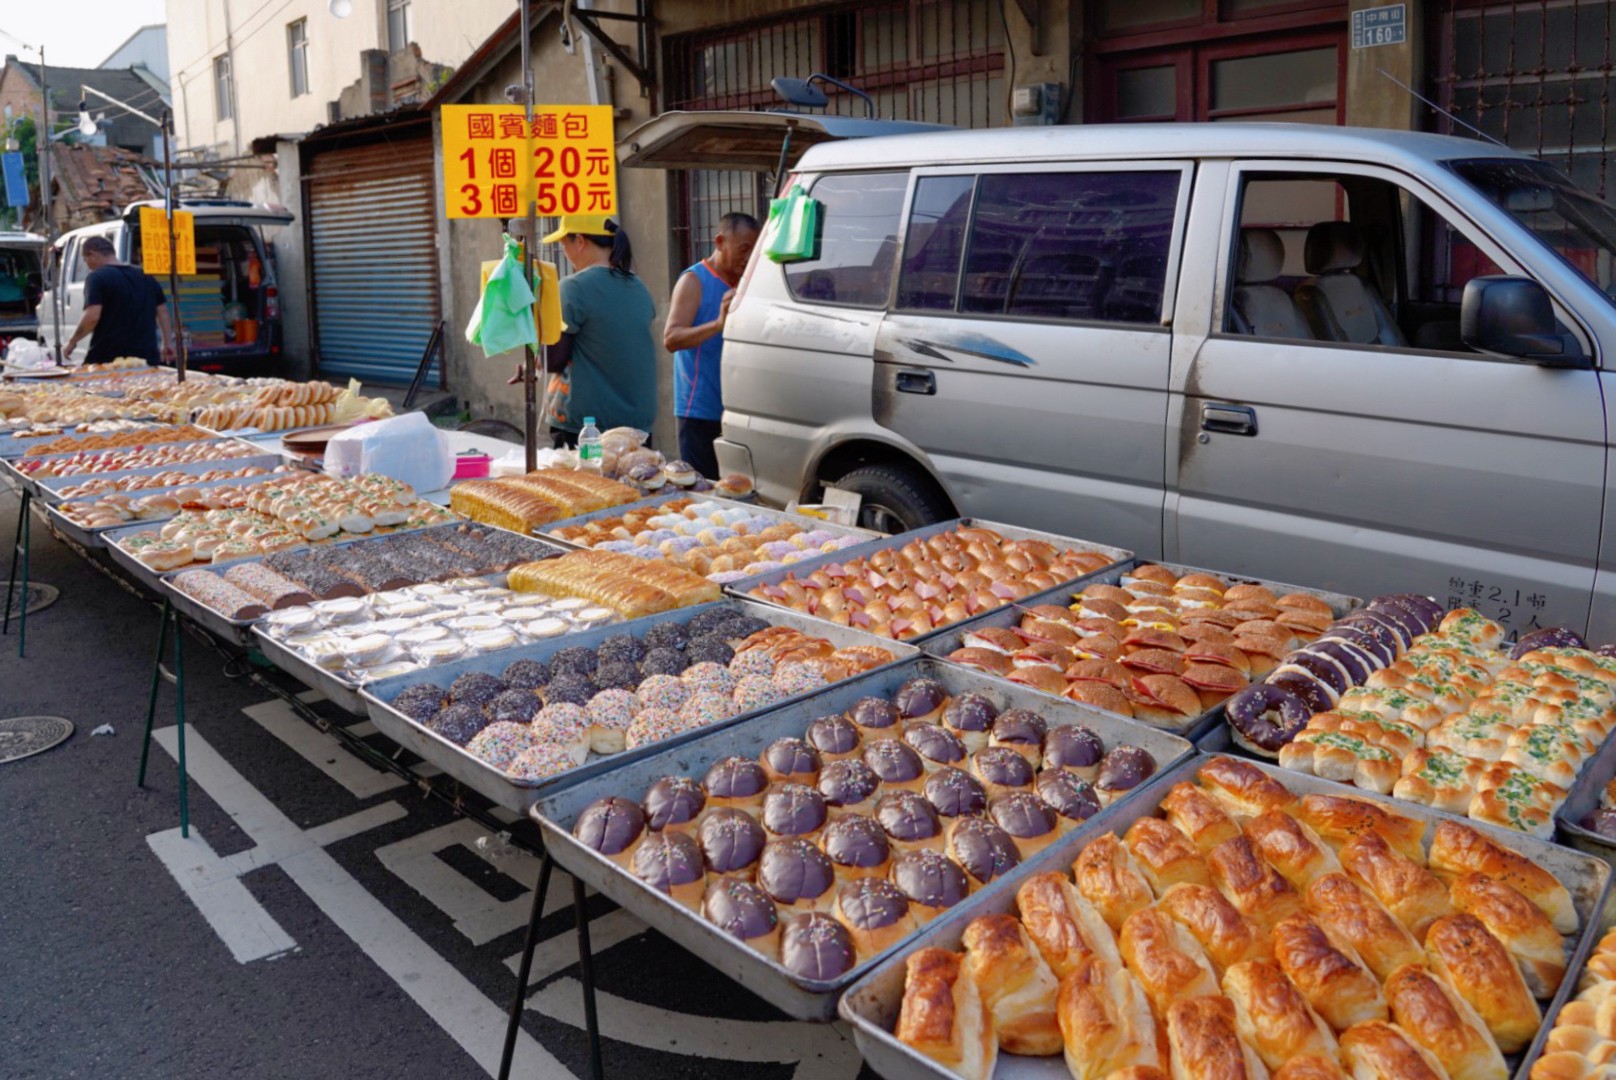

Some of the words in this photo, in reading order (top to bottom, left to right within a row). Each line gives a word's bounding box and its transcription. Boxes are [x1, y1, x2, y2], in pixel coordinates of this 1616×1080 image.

[467, 112, 588, 140] 國賓麵包
[459, 147, 516, 179] 1個
[533, 147, 610, 179] 20元
[460, 183, 518, 216] 3個
[537, 182, 611, 215] 50元
[1497, 607, 1512, 623] 2
